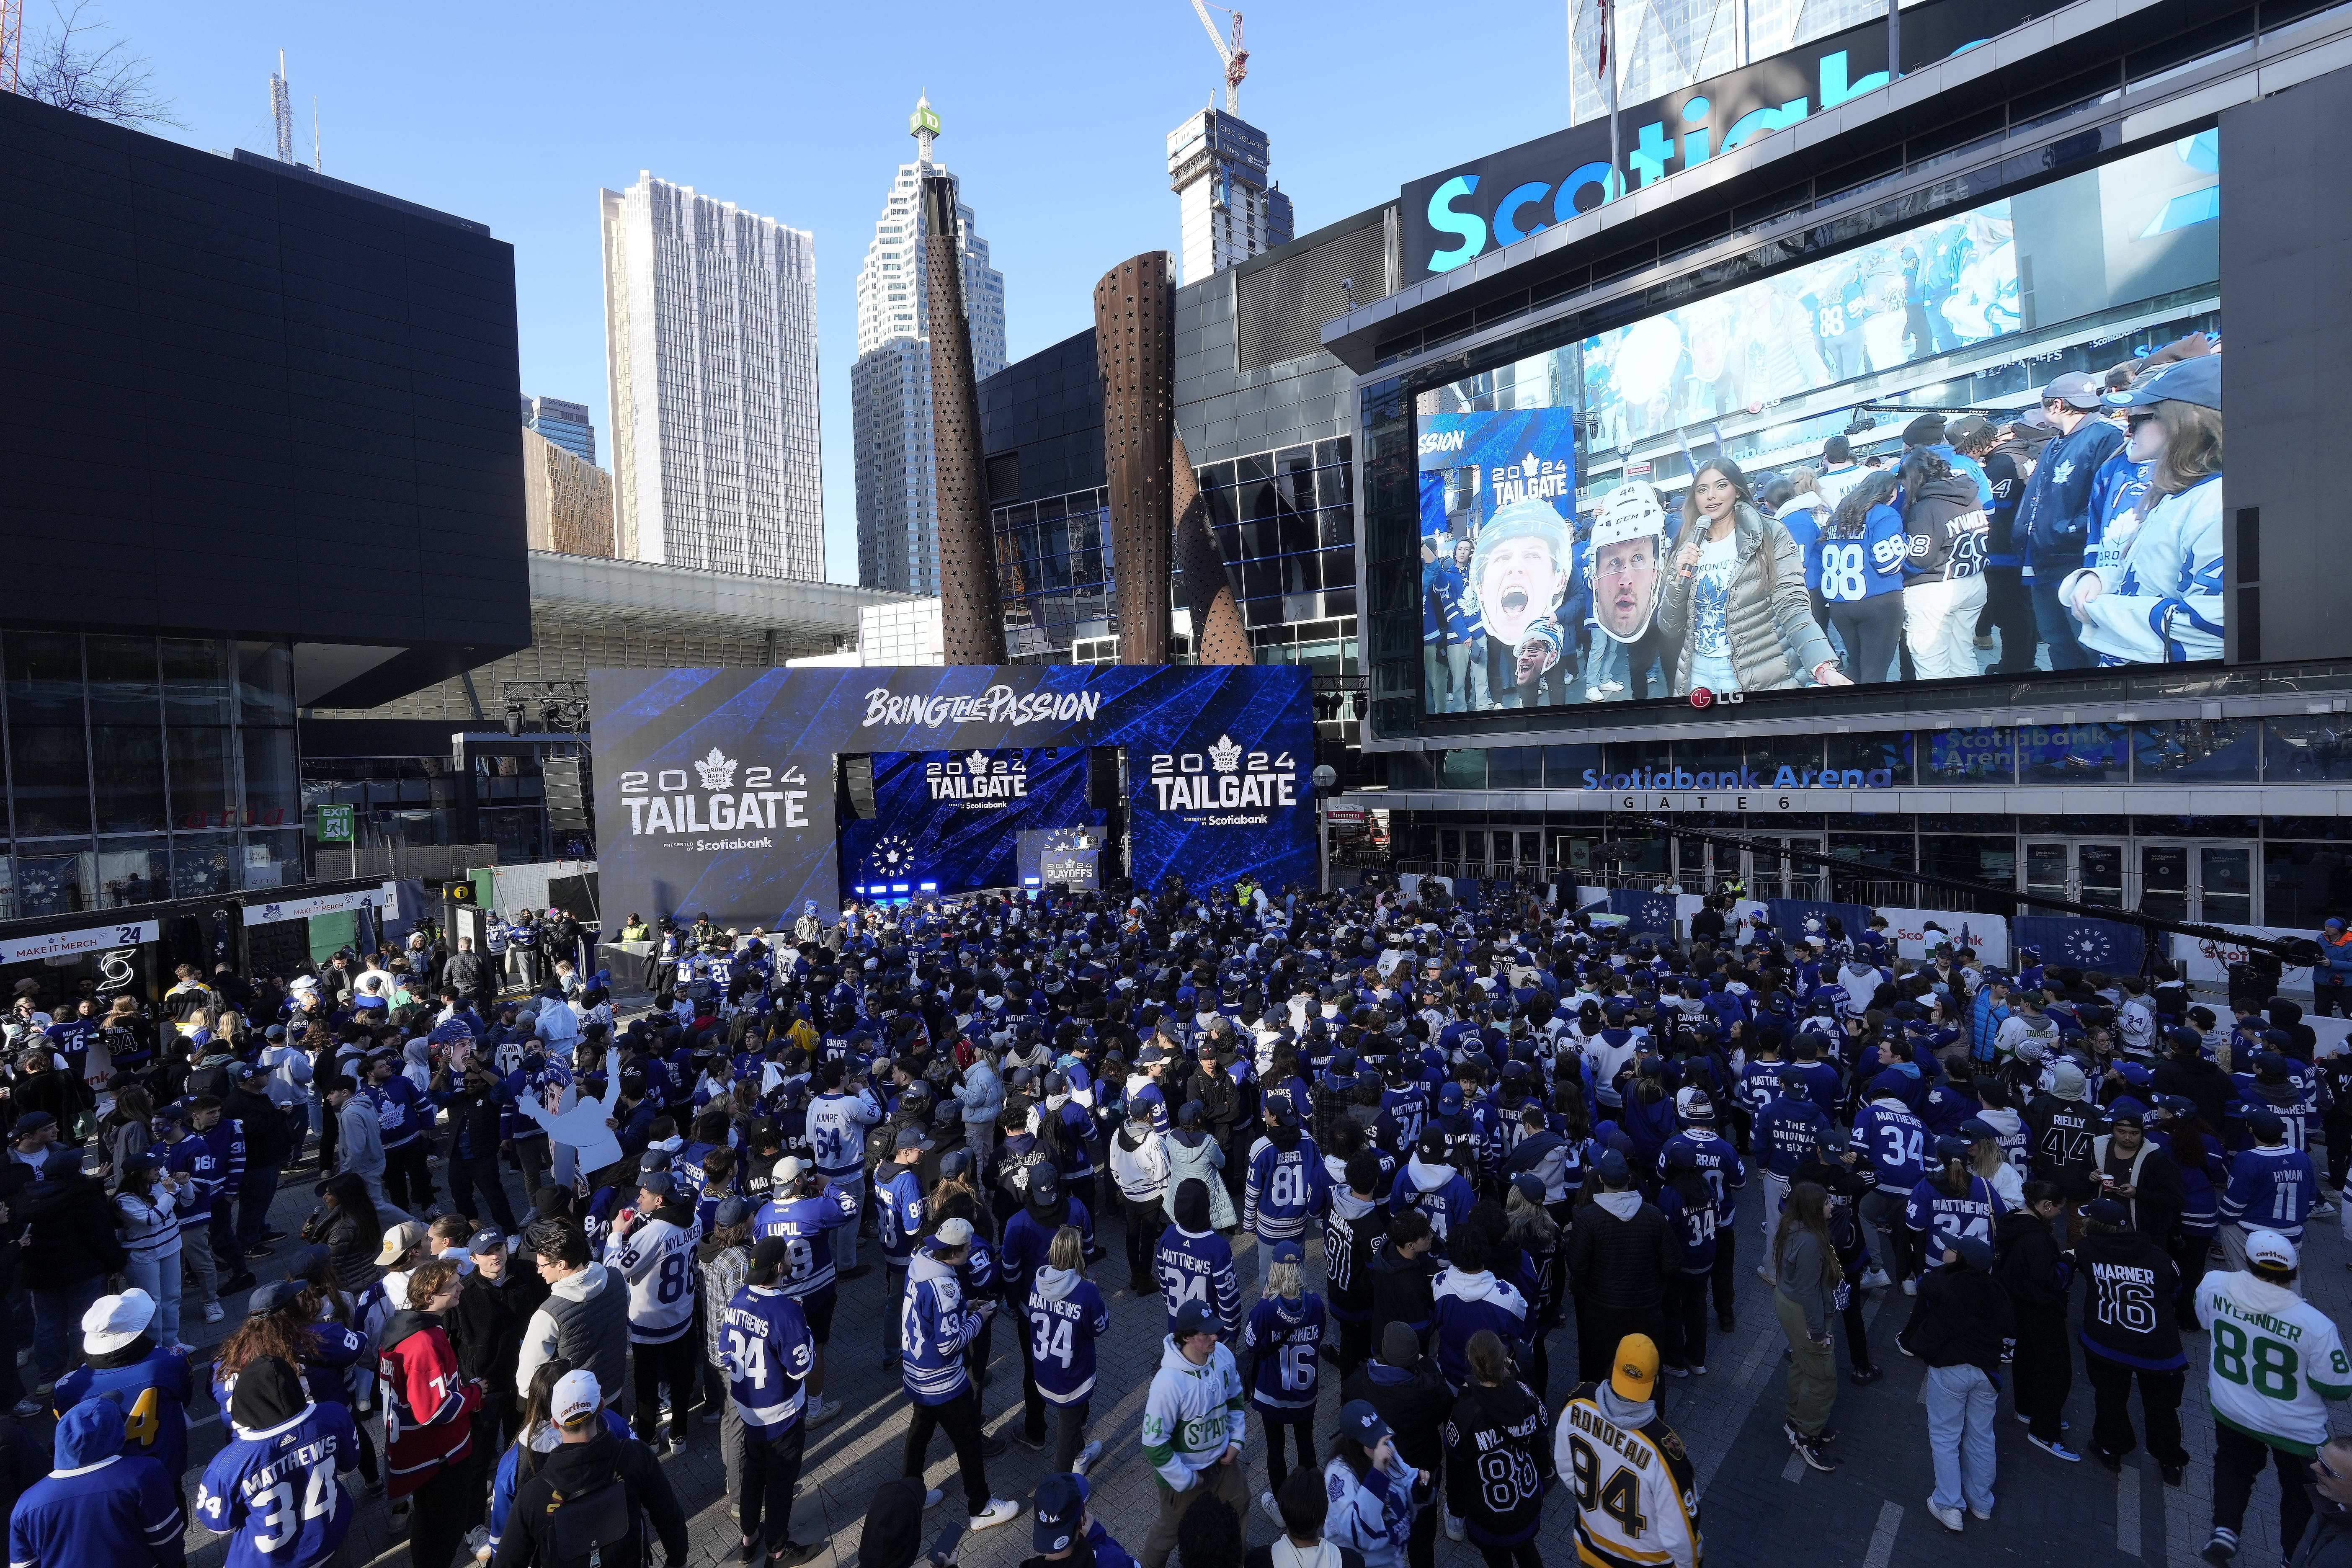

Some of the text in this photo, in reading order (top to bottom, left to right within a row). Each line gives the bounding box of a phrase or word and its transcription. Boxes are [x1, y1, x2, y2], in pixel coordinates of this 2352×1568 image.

[1427, 38, 1993, 273] Scotiab
[1616, 513, 1639, 524] CCM
[1821, 544, 1867, 601] 88
[1717, 688, 1743, 704] LG
[1945, 727, 2108, 749] Scotiabank
[1946, 750, 2030, 765] Arena
[927, 775, 1027, 799] TAILGATE
[1582, 765, 1892, 790] Scotiabank Arena
[1152, 774, 1296, 810] TAILGATE
[1623, 796, 1790, 810] GATE 6
[323, 808, 349, 816] EXIT
[622, 791, 809, 835] TAILGATE
[1209, 814, 1267, 826] Scotiabank
[696, 837, 772, 851] Scotiabank
[1047, 869, 1092, 878] PLAYOFFS
[16, 946, 47, 957] MAKE
[62, 939, 97, 950] MERCH
[116, 926, 141, 943] '24
[486, 931, 500, 943] 17
[678, 969, 691, 982] 44
[712, 965, 731, 982] 21
[1677, 1014, 1708, 1022] CAMPBELL
[2128, 1015, 2143, 1026] 34
[64, 1034, 84, 1052] 16
[106, 1032, 138, 1055] 34
[826, 1038, 847, 1047] TAVARES
[2026, 1029, 2053, 1038] TAVARES
[502, 1054, 521, 1075] 13
[816, 1114, 838, 1123] KAMPF
[1392, 1100, 1423, 1117] MATTHEWS
[1875, 1110, 1921, 1129] MATTHEWS
[2267, 1104, 2306, 1115] TAVARES
[1786, 1120, 1805, 1131] THE
[2053, 1114, 2086, 1128] RIELLY
[788, 1137, 806, 1149] 64
[815, 1128, 842, 1159] 64
[1773, 1130, 1816, 1144] ORIGINAL
[1787, 1143, 1803, 1153] SIX
[1880, 1125, 1924, 1171] 34
[2040, 1127, 2095, 1166] 44
[194, 1155, 210, 1171] 16
[998, 1155, 1022, 1176] MAPLE
[1277, 1150, 1303, 1164] KESSEL
[1271, 1164, 1307, 1206] 81
[2273, 1170, 2303, 1183] HYMAN
[1932, 1199, 1990, 1215] MATTHEWS
[2272, 1182, 2297, 1221] 11
[767, 1222, 801, 1236] LUPUL
[1329, 1209, 1354, 1241] TAVARES
[1688, 1210, 1715, 1247] 34
[1932, 1213, 1991, 1256] 34
[665, 1226, 701, 1252] NYLANDER
[1161, 1253, 1211, 1275] MATTHEWS
[1326, 1228, 1352, 1290] 91
[2256, 1252, 2288, 1262] carlton
[658, 1245, 699, 1304] 88
[2092, 1262, 2154, 1284] MARNER
[746, 1294, 759, 1303] Reebok
[1029, 1291, 1081, 1316] MATTHEWS
[1165, 1268, 1207, 1317] 34
[2095, 1276, 2156, 1333] 16
[725, 1308, 769, 1338] MATTHEWS
[940, 1313, 959, 1336] 43
[2213, 1294, 2303, 1344] NYLANDER
[1030, 1312, 1074, 1369] 34
[728, 1329, 768, 1389] 34
[1279, 1344, 1316, 1391] 16
[2213, 1318, 2298, 1402] 88
[561, 1400, 591, 1417] carlton
[1143, 1413, 1163, 1437] 34
[1570, 1403, 1652, 1471] RONDEAU
[242, 1435, 336, 1496] MATTHEWS
[1478, 1444, 1538, 1513] 88
[1568, 1432, 1646, 1540] 94
[196, 1483, 222, 1519] 34
[250, 1455, 336, 1553] 34
